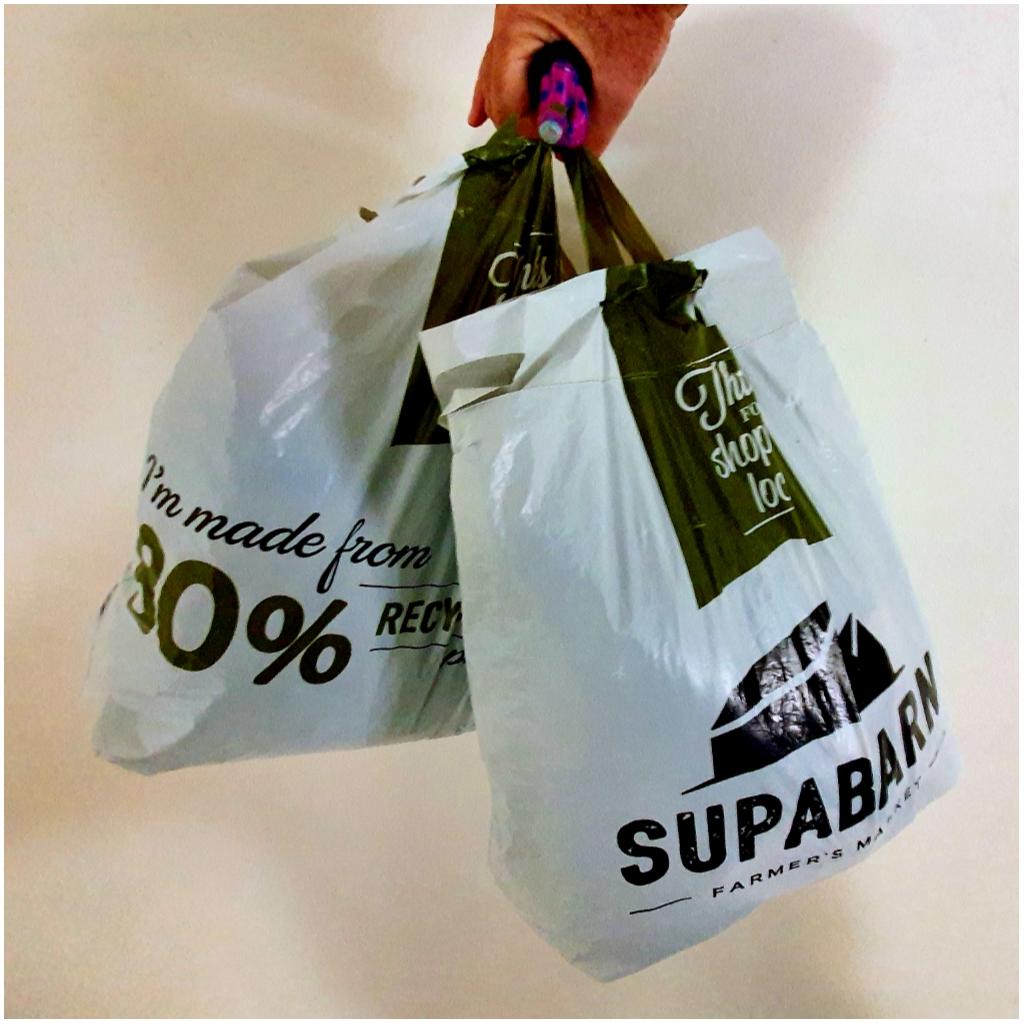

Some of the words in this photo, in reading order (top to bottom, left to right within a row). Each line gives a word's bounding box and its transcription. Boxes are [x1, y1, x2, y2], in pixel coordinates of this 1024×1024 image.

[183, 512, 327, 558] made
[316, 518, 432, 594] from
[616, 650, 940, 887] SUPABARN
[712, 848, 843, 899] FARMER'S
